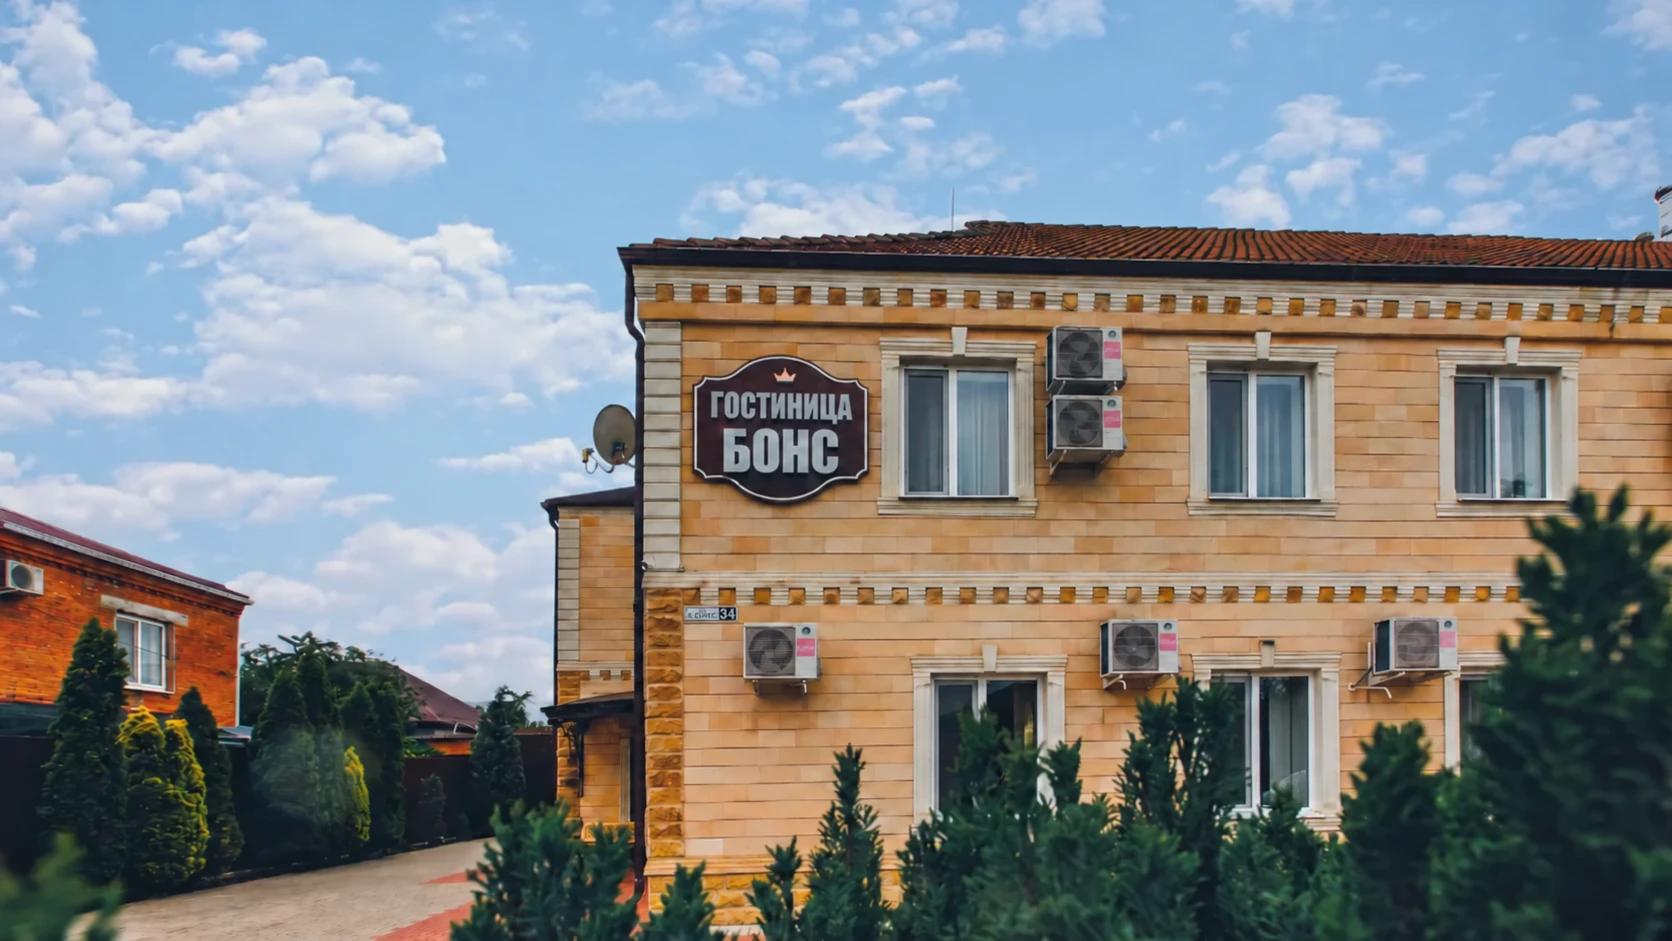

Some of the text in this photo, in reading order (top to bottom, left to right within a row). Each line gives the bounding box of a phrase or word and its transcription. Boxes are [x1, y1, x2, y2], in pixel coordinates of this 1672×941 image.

[710, 391, 853, 425] ГОСТИНИЦА
[723, 427, 839, 474] БОНС
[719, 608, 736, 620] 34
